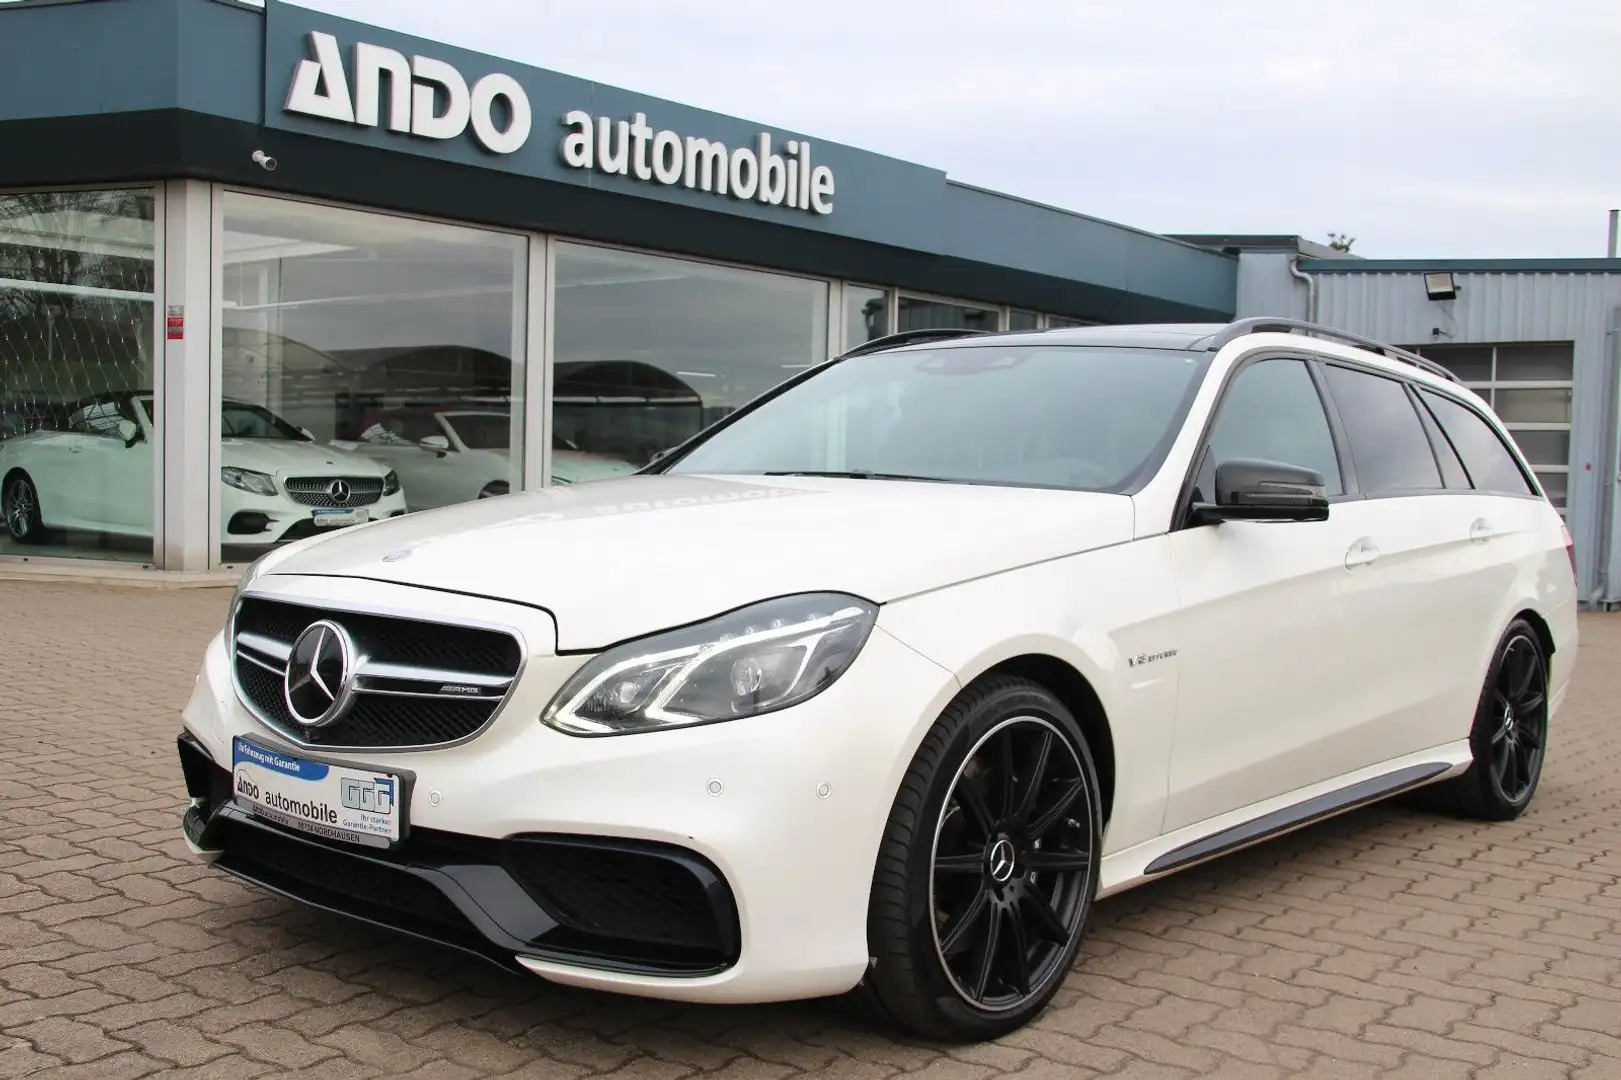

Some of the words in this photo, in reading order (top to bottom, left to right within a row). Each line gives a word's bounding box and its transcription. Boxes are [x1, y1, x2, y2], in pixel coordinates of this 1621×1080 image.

[284, 31, 532, 154] ANDO
[559, 110, 835, 215] automobile
[273, 756, 300, 772] Garantie
[265, 791, 338, 824] automobile
[360, 813, 369, 822] Ihr
[312, 825, 361, 842] NORDHAUSEN
[342, 818, 392, 835] Garantie-Partner
